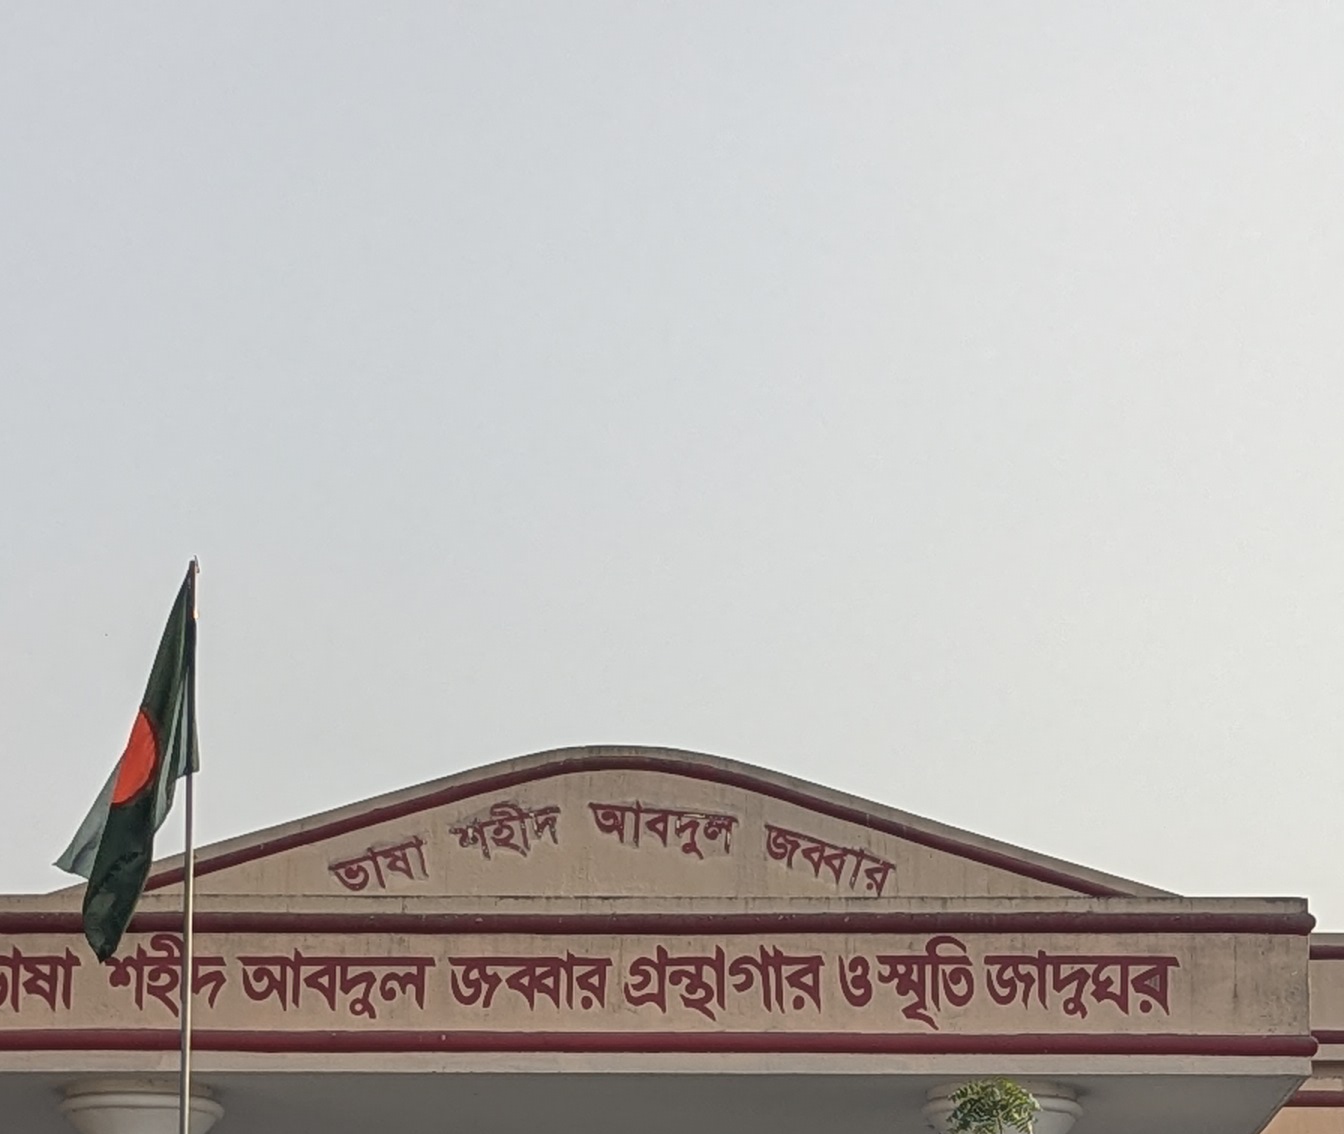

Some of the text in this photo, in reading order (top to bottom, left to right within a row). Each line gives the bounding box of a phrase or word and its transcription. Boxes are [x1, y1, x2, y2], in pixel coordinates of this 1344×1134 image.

[328, 800, 896, 897] ভাষা শহীদ আবদুল জব্বার
[105, 933, 227, 1018] শহীদ
[237, 948, 436, 1019] আবদুল
[449, 950, 612, 1010] জব্বার
[623, 945, 825, 1021] গ্রন্থাগার
[984, 950, 1180, 1019] জাদুঘর
